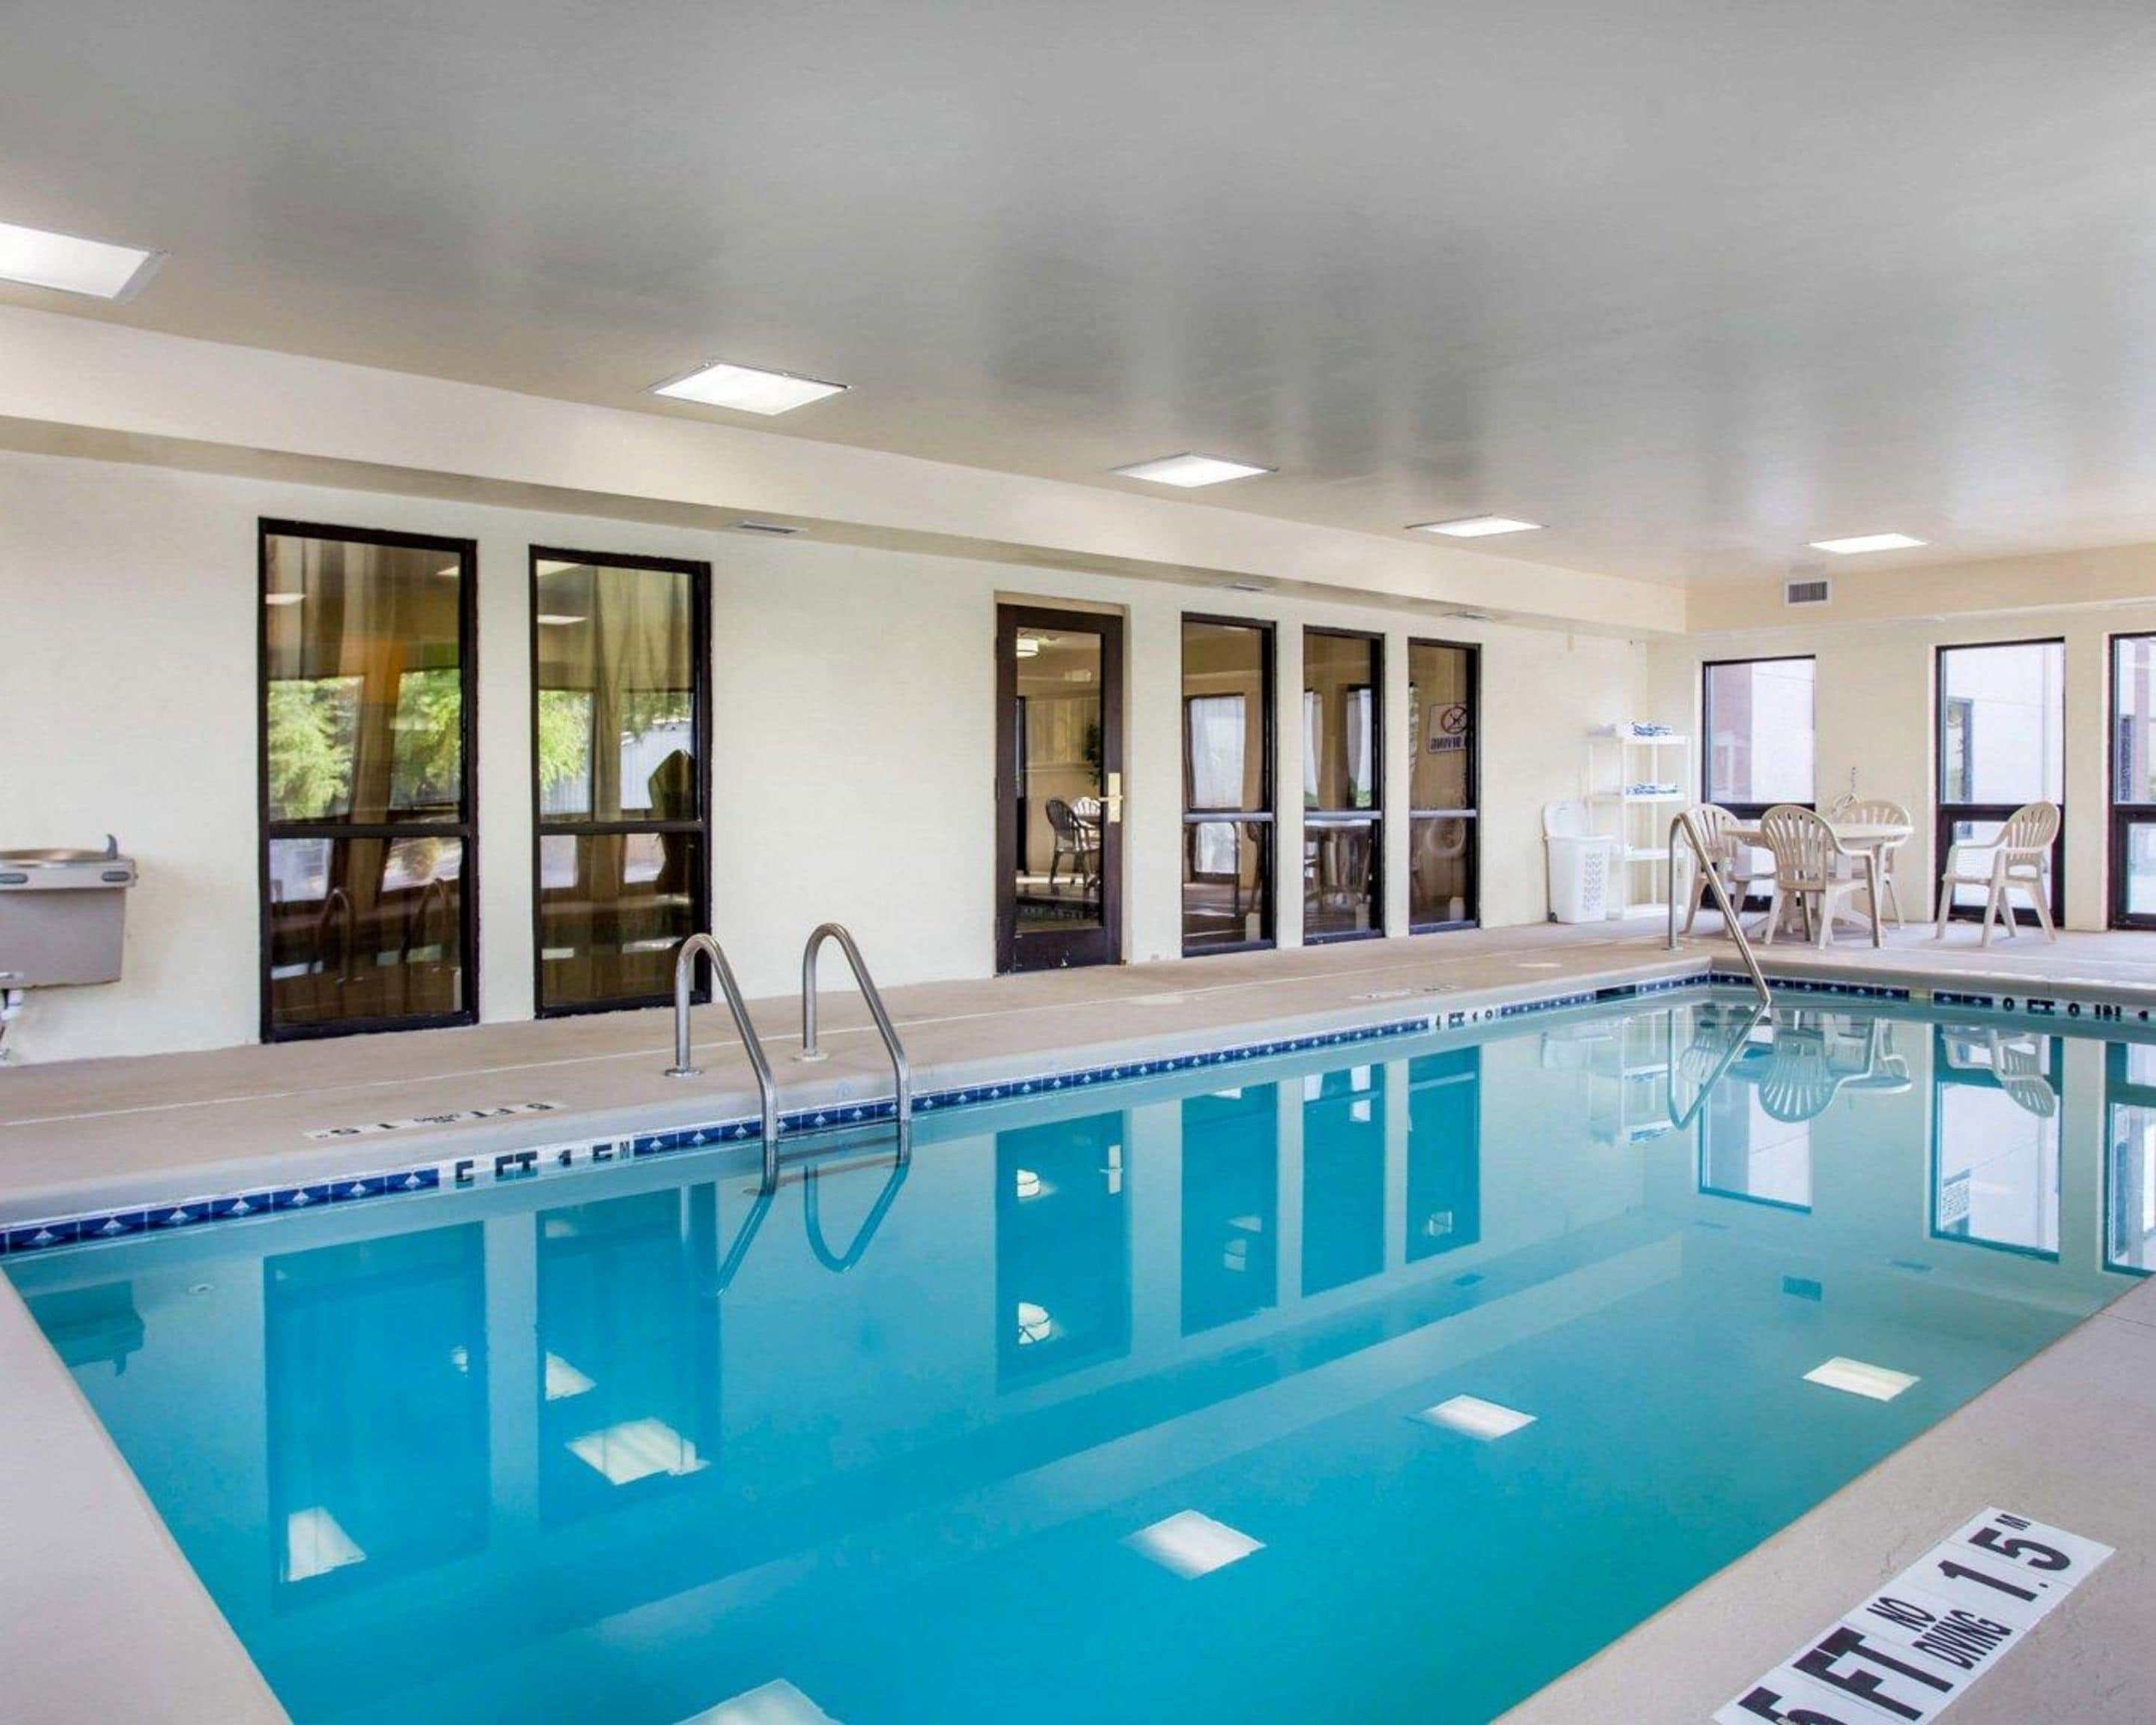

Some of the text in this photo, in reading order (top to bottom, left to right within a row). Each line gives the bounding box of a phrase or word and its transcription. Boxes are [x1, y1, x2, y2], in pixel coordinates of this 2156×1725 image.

[1866, 1597, 1937, 1632] NO
[1911, 1610, 2012, 1670] DIVING
[1792, 1627, 1954, 1721] FT
